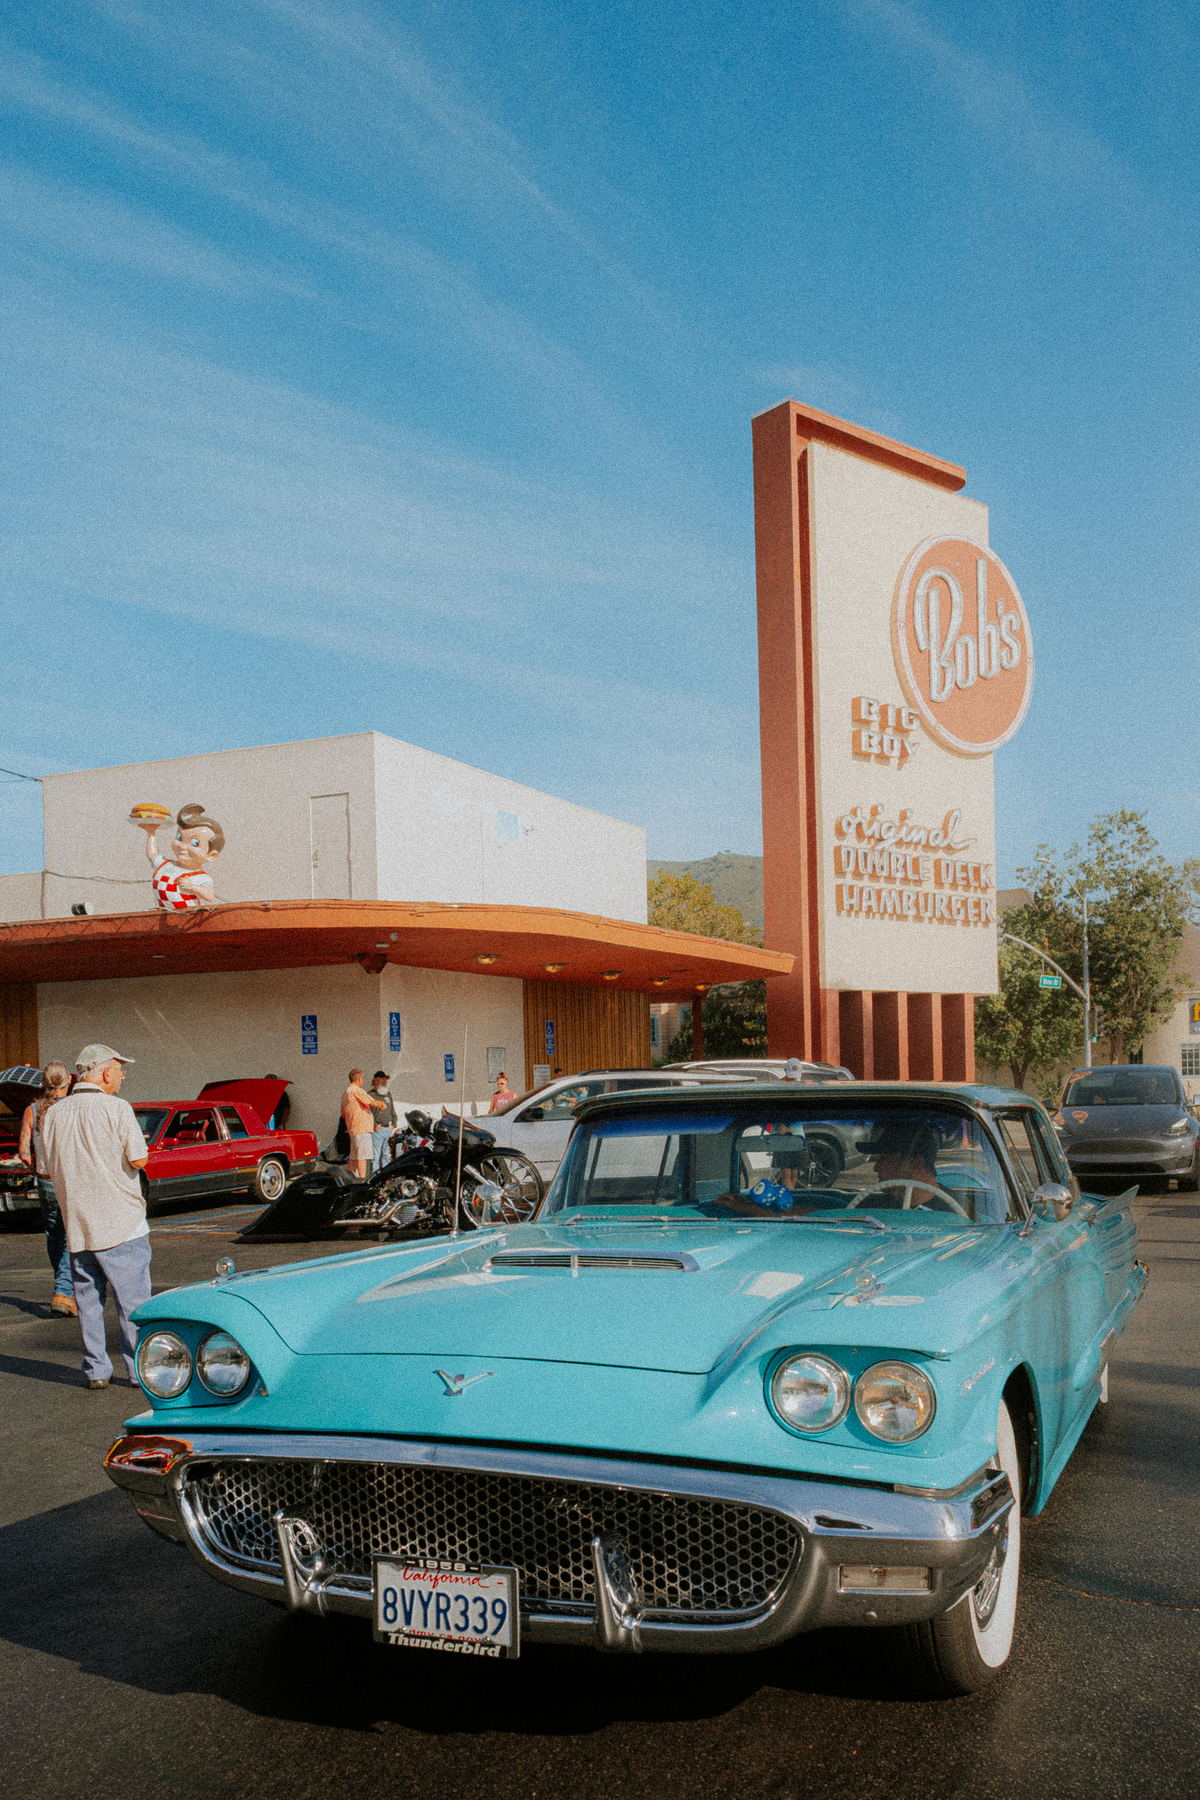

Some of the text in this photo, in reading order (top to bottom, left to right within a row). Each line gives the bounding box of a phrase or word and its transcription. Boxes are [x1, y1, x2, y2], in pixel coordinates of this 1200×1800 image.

[914, 557, 1021, 702] Bob's
[852, 696, 922, 732] BIG
[852, 729, 922, 768] BOY
[835, 803, 978, 851] original
[833, 845, 994, 890] DOUBLE DECK
[835, 884, 995, 924] HAMBURGER
[403, 1567, 490, 1589] California
[383, 1587, 508, 1636] 8VYR339
[388, 1633, 501, 1658] Thunderbird
